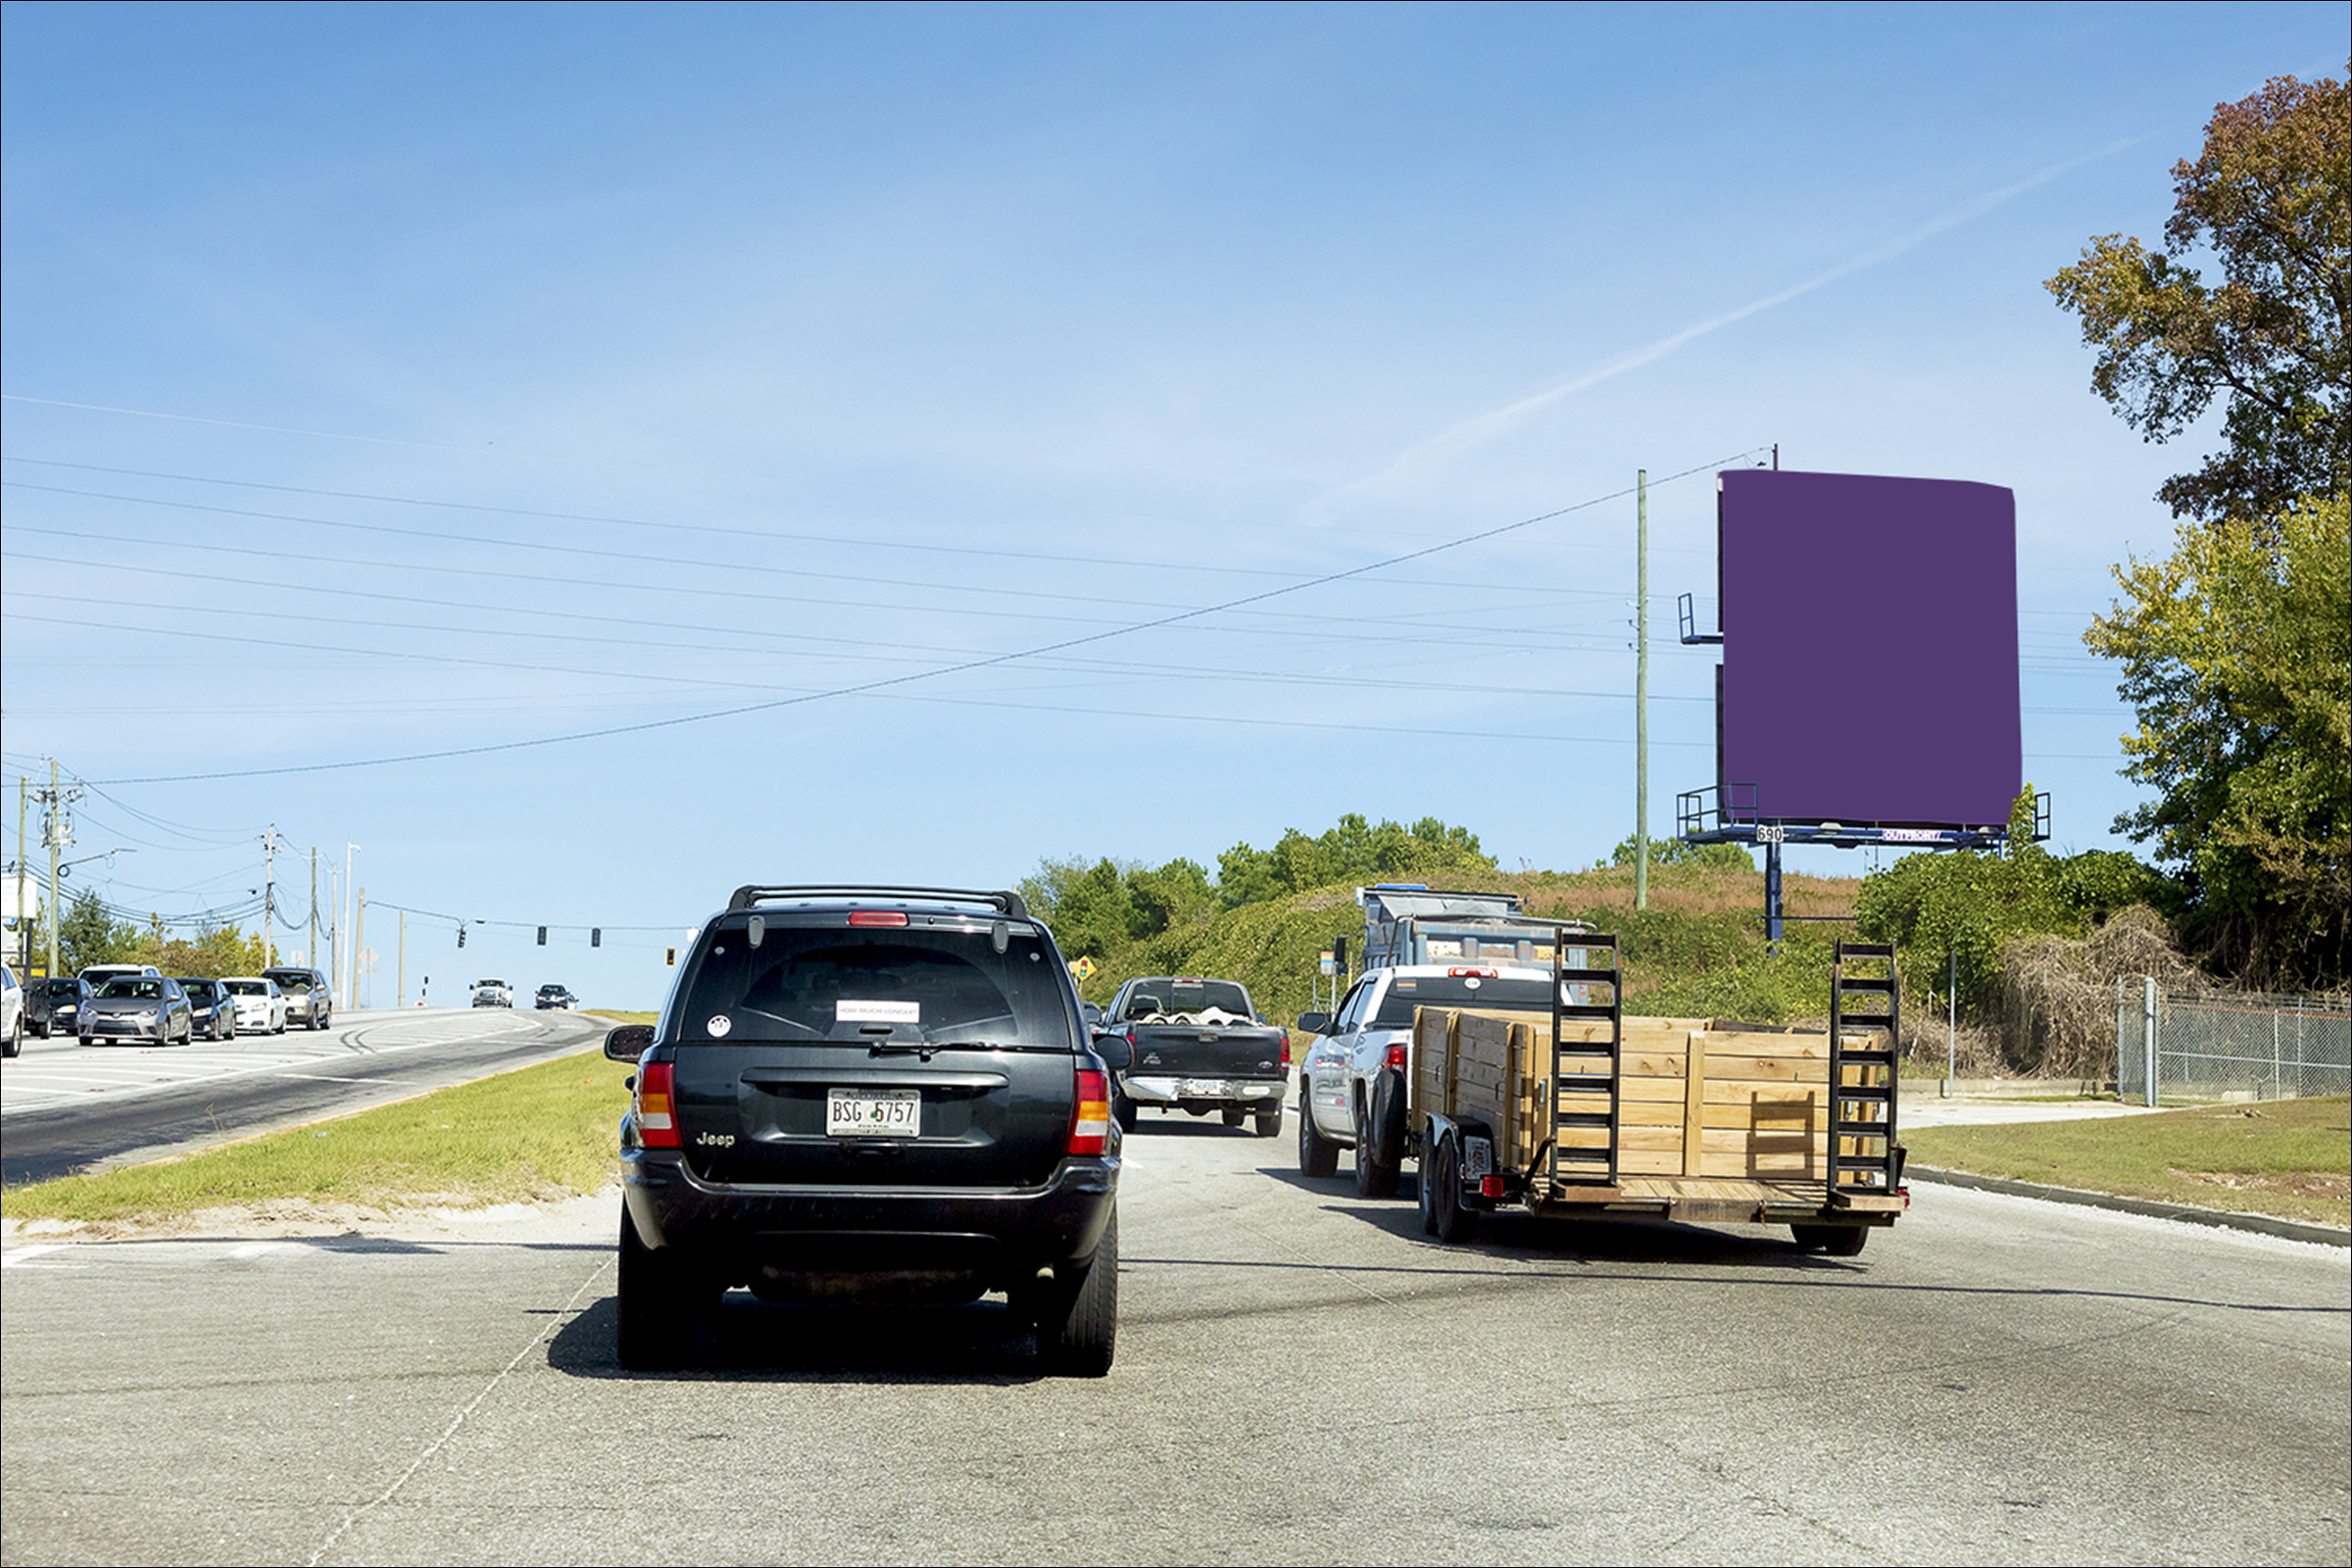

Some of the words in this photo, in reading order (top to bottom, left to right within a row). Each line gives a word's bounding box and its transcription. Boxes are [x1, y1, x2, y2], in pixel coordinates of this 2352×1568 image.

[1758, 826, 1783, 841] 690
[833, 1101, 861, 1122] BSG
[875, 1102, 914, 1123] 5757
[696, 1131, 735, 1148] Jeep
